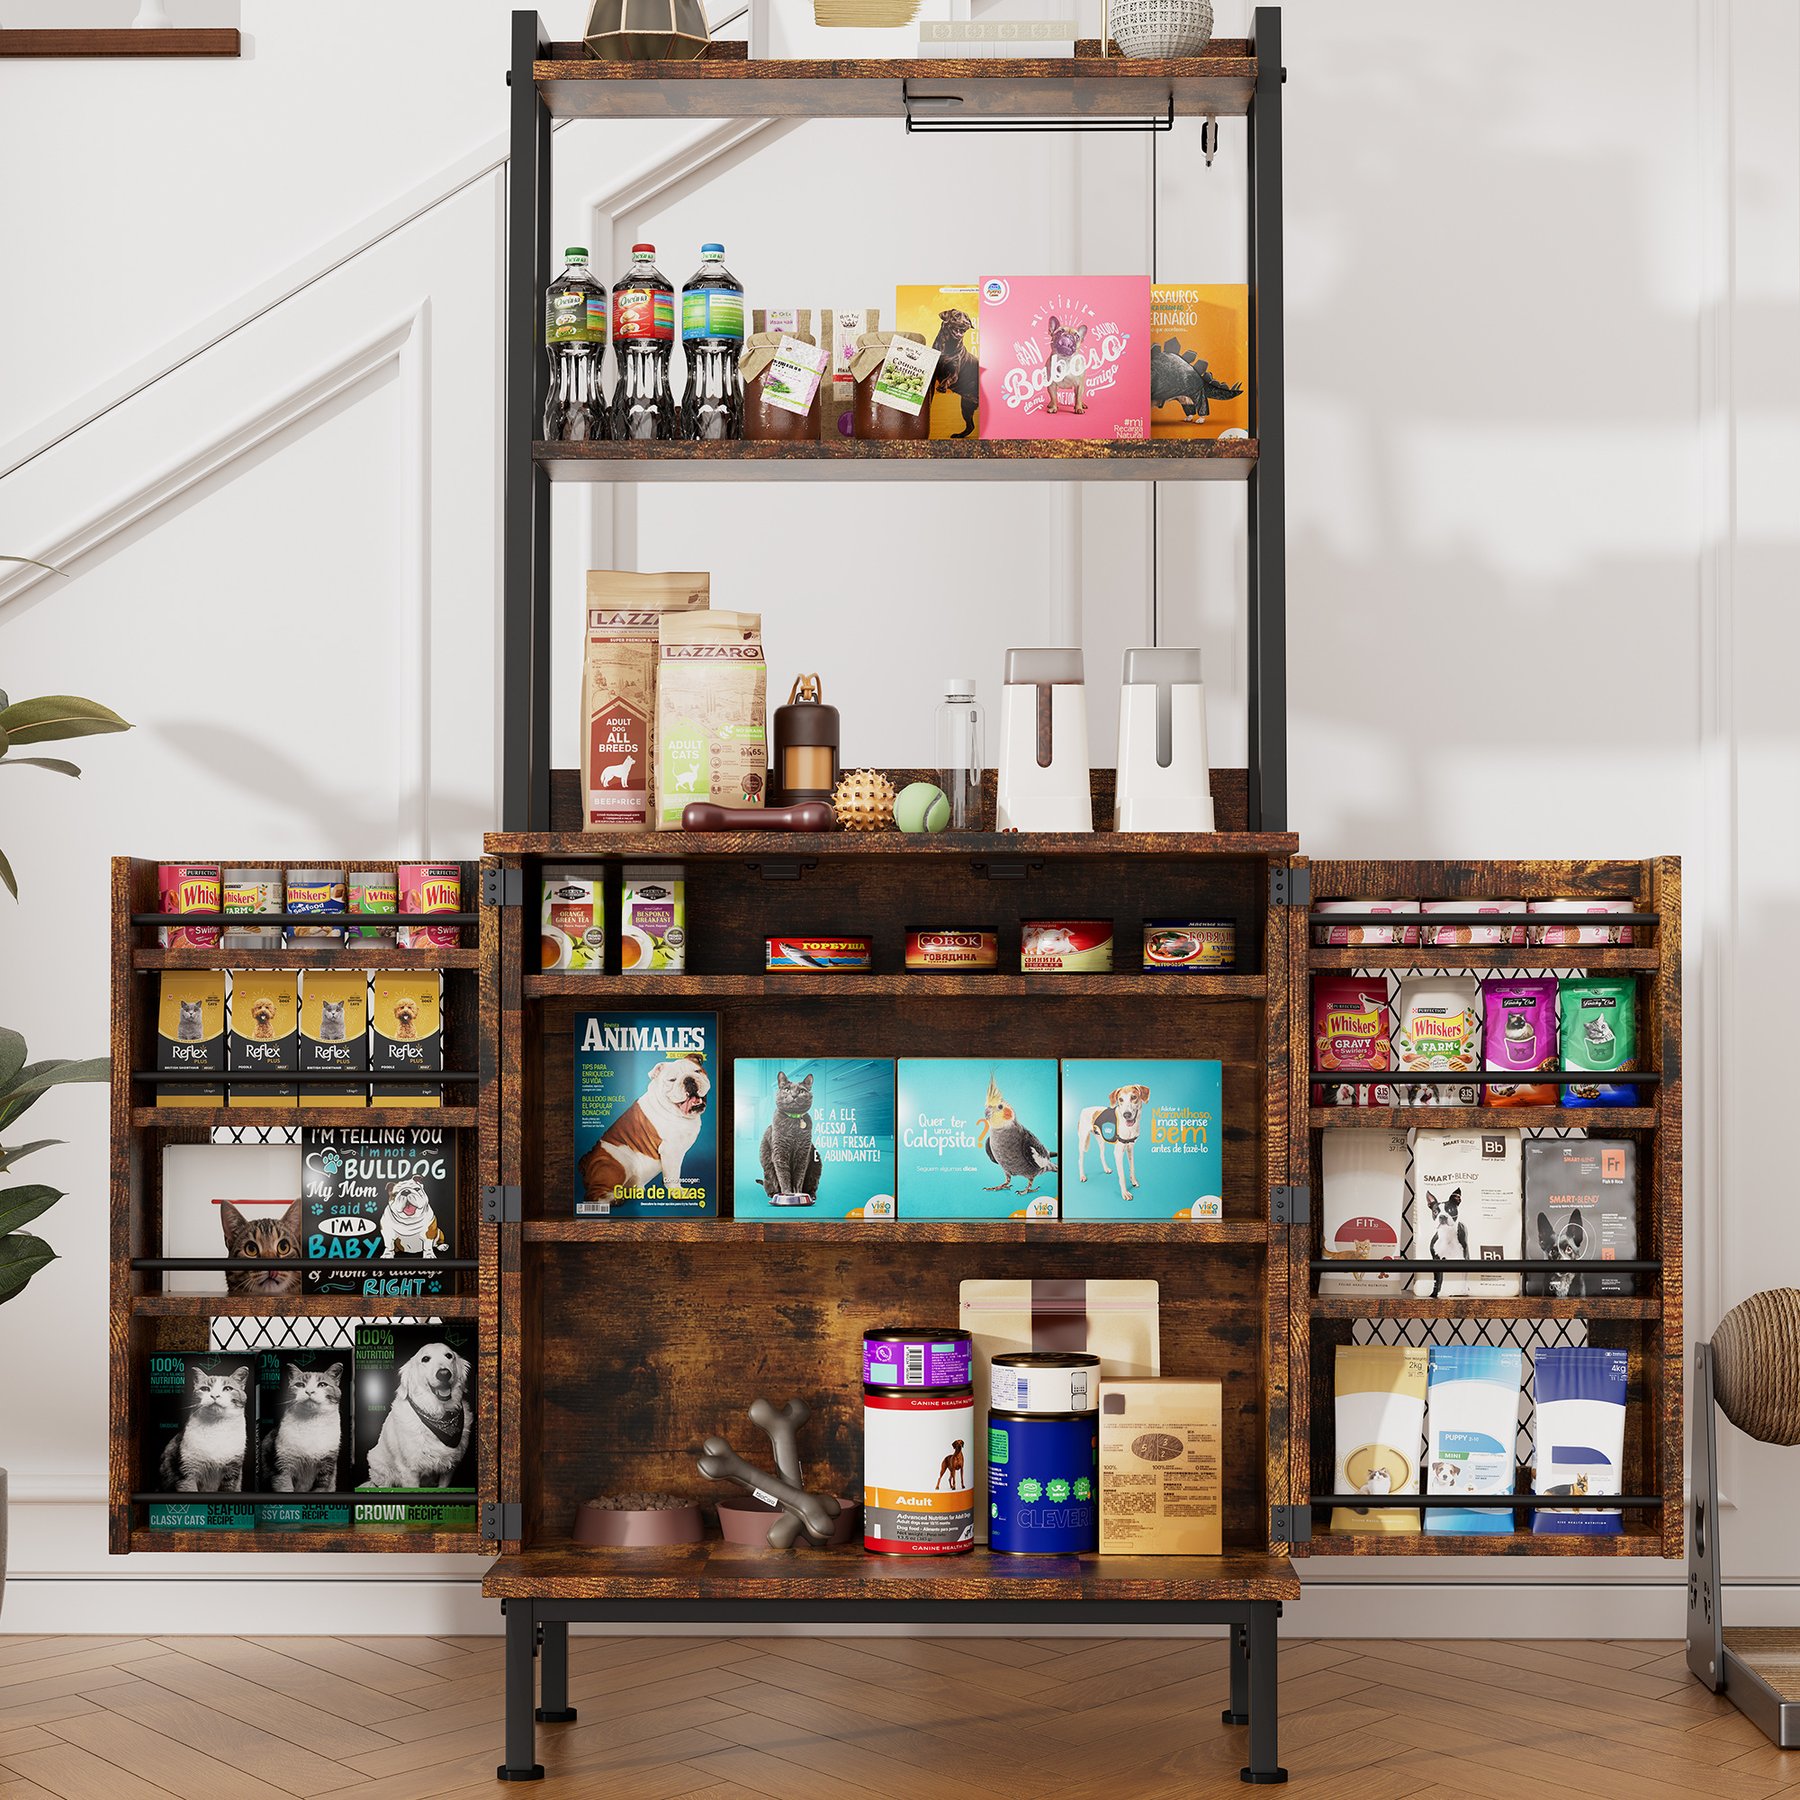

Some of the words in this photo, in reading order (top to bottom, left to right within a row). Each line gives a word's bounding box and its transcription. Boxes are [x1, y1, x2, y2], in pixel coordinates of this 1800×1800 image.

[1003, 335, 1127, 408] Baboso
[1086, 364, 1119, 390] amigo
[1114, 425, 1144, 434] Recarga
[666, 645, 759, 658] LAZZARO
[606, 718, 631, 727] ADULT
[606, 733, 630, 743] ALL
[599, 743, 638, 753] BREEDS
[669, 740, 703, 750] ADULT
[672, 750, 700, 760] CATS
[288, 889, 327, 901] Whiskers
[293, 902, 325, 914] Seafood
[921, 936, 980, 946] СОВОК
[923, 953, 977, 962] ГОВЯДИНА
[1330, 1015, 1377, 1034] Whiskers
[1415, 1020, 1462, 1037] Whiskers
[581, 1018, 705, 1051] ANIMALES
[1335, 1039, 1371, 1048] GRAVY
[1422, 1043, 1455, 1052] FARM
[173, 1045, 207, 1061] Reflex
[246, 1044, 281, 1060] Reflex
[315, 1045, 350, 1061] Reflex
[389, 1044, 423, 1060] Reflex
[829, 1109, 837, 1121] A
[840, 1109, 856, 1121] ELE
[1152, 1107, 1212, 1120] Maravilhoso,
[919, 1114, 945, 1127] Quer
[951, 1115, 967, 1128] ter
[1180, 1119, 1208, 1131] pense
[814, 1122, 847, 1134] ACESSO
[1151, 1118, 1207, 1144] bem
[311, 1129, 334, 1144] I'M
[340, 1129, 405, 1144] TELLING
[411, 1129, 442, 1144] YOU
[843, 1136, 876, 1148] FRESCA
[903, 1129, 976, 1156] Calopsita
[360, 1146, 380, 1157] I'm
[384, 1147, 405, 1157] not
[409, 1149, 416, 1157] a
[1151, 1144, 1171, 1153] antes
[1172, 1143, 1182, 1153] de
[1485, 1142, 1503, 1152] Bb
[813, 1150, 820, 1162] E
[824, 1150, 881, 1163] ABUNDANTE!
[345, 1159, 446, 1180] BULLDOG
[1607, 1157, 1620, 1171] Fr
[306, 1181, 334, 1202] My
[338, 1181, 378, 1198] Mom
[613, 1184, 644, 1199] Guía
[647, 1184, 665, 1199] de
[667, 1188, 705, 1199] razas
[331, 1202, 360, 1215] said
[331, 1219, 353, 1233] I'M
[357, 1219, 367, 1232] A
[1356, 1219, 1374, 1228] FIT
[308, 1234, 382, 1259] BABY
[362, 1279, 426, 1297] RIGHT
[356, 1329, 394, 1345] 100%
[356, 1351, 394, 1359] NUTRITION
[150, 1357, 185, 1372] 100%
[1409, 1361, 1422, 1370] 2kg
[1611, 1365, 1626, 1374] 4kg
[150, 1376, 185, 1385] NUTRITION
[1141, 1444, 1148, 1452] 5
[1162, 1438, 1168, 1446] 3
[896, 1496, 933, 1506] Adult
[207, 1504, 255, 1516] SEAFOOD
[279, 1509, 300, 1520] CATS
[301, 1510, 329, 1520] RECIPE
[355, 1504, 405, 1521] CROWN
[408, 1508, 443, 1521] RECIPE
[150, 1514, 181, 1525] CLASSY
[184, 1514, 205, 1525] CATS
[207, 1515, 234, 1525] RECIPE
